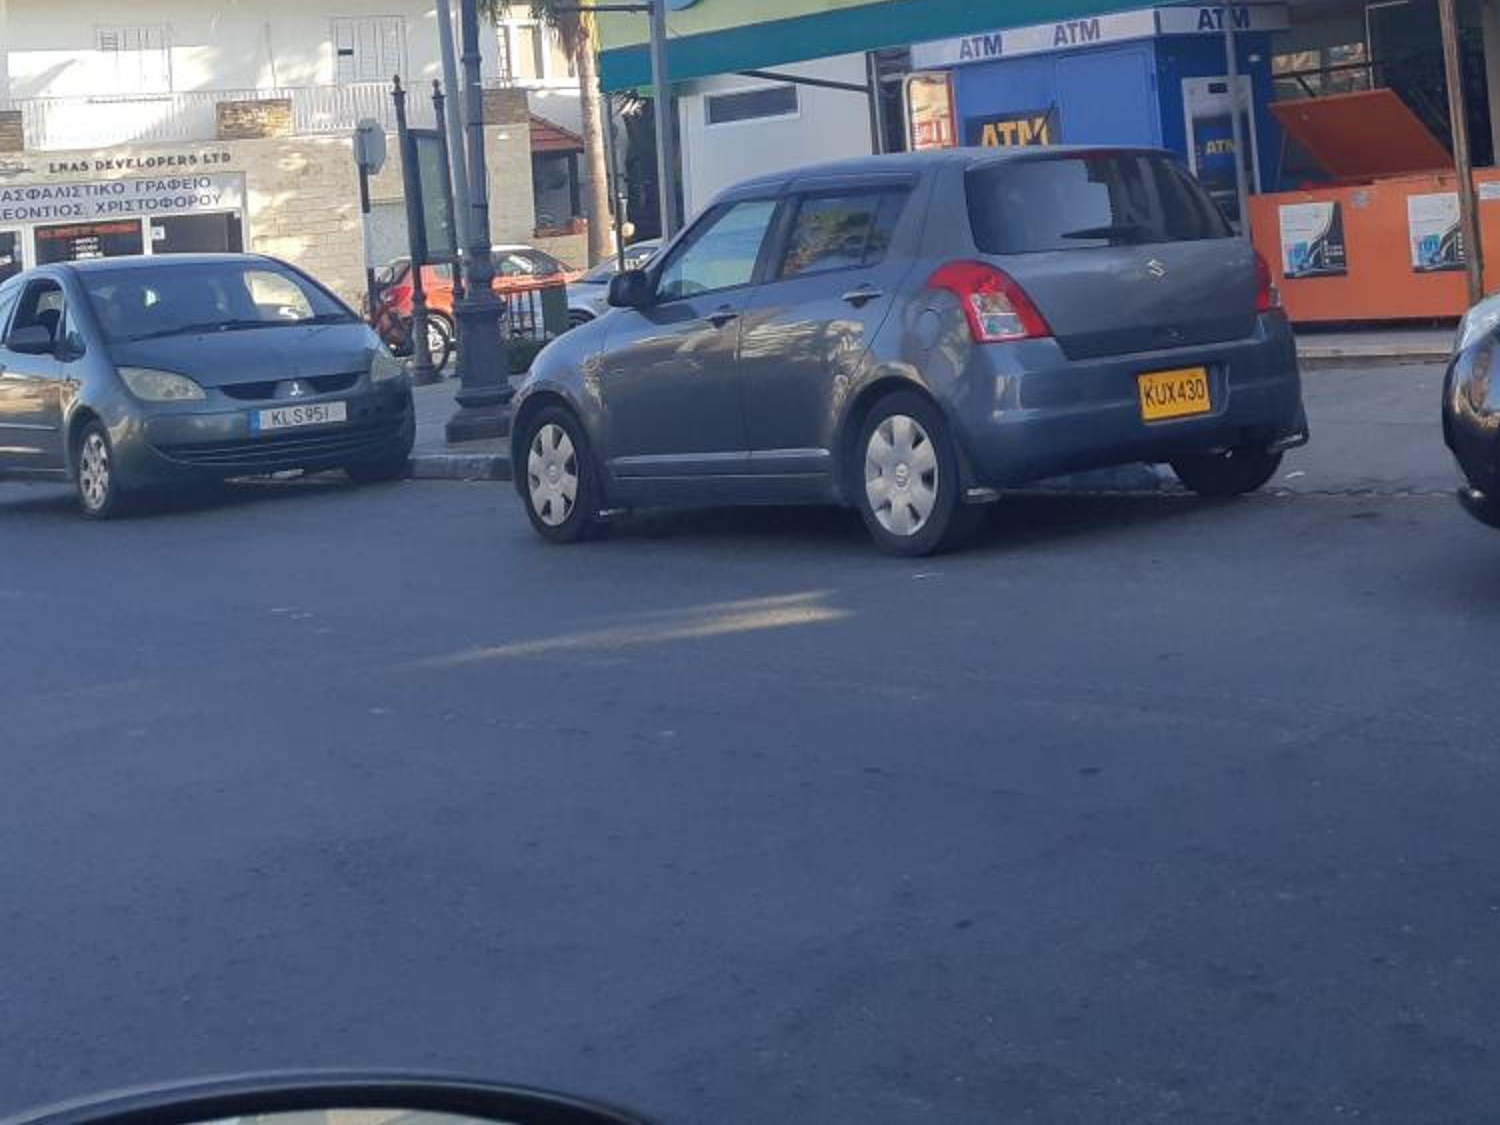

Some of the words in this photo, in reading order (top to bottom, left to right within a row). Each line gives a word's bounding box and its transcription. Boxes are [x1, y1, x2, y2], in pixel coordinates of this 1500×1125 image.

[1198, 8, 1249, 30] ATM
[1054, 19, 1099, 47] ATM
[959, 35, 1003, 60] ATM
[981, 118, 1049, 148] ATM
[203, 152, 232, 165] LTD
[1, 182, 125, 203] ΑΣΦΑΛΙΣΤΙΚΟ
[135, 177, 212, 193] ΓΡΑΦΕΙΟ
[2, 203, 85, 220] ΕΟΝΤΙΟΣ
[95, 193, 221, 214] ΧΡΙΣΤΟΦΟΡΟΥ
[1143, 378, 1205, 409] KUX430
[271, 407, 329, 426] KLS951
